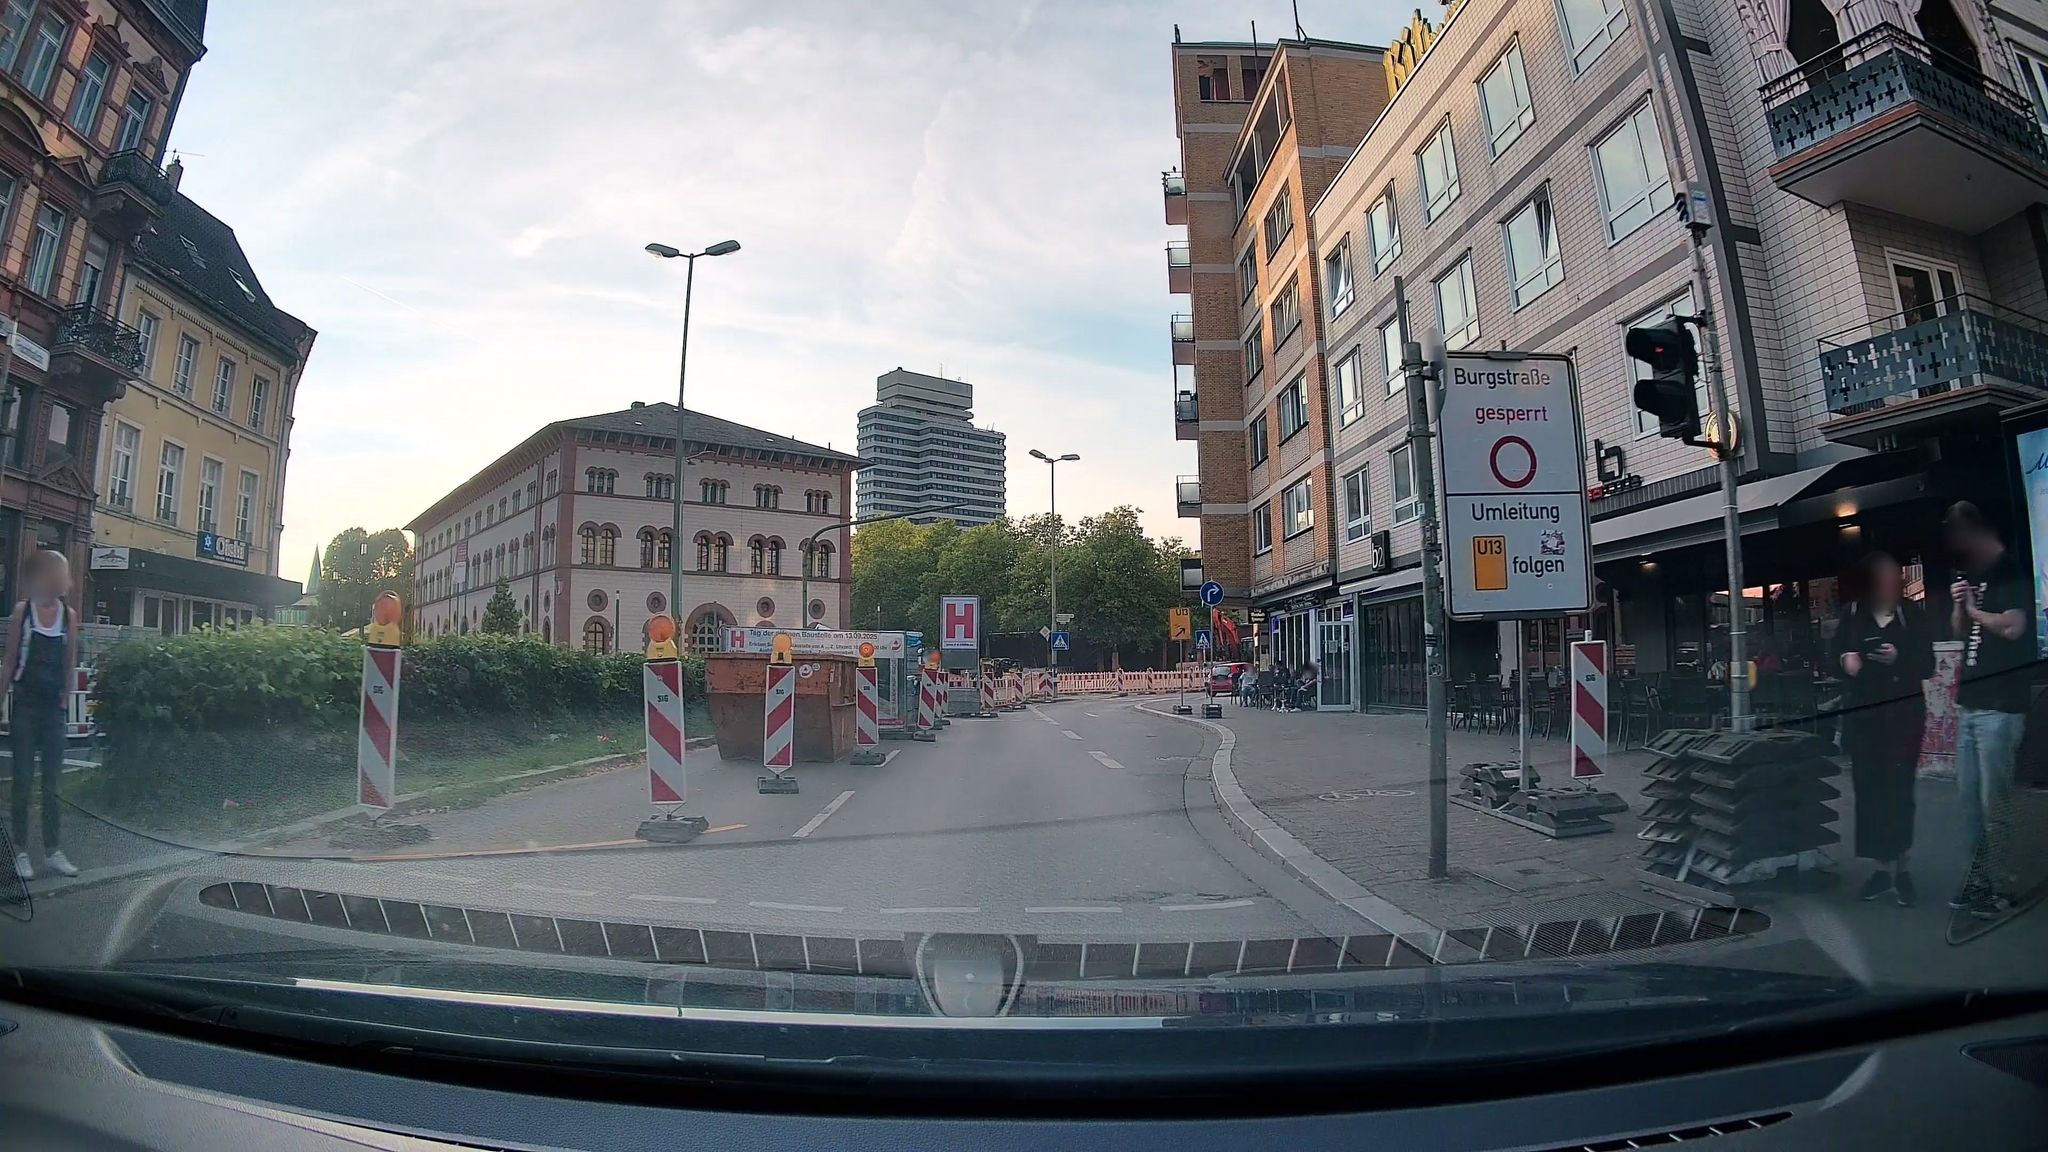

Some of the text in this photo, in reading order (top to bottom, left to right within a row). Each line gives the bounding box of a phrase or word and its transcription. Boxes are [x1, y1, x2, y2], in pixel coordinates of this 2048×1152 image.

[1454, 368, 1550, 389] Burgstraße
[1475, 406, 1548, 425] gesperrt
[1471, 502, 1560, 523] Umleitung
[216, 537, 247, 560] Oishi
[1477, 540, 1503, 556] U13
[1513, 556, 1565, 577] folgen
[946, 603, 974, 639] H
[1175, 608, 1189, 616] U13
[749, 629, 762, 638] Tag
[801, 631, 832, 639] Baustelle
[657, 694, 669, 703] SIG
